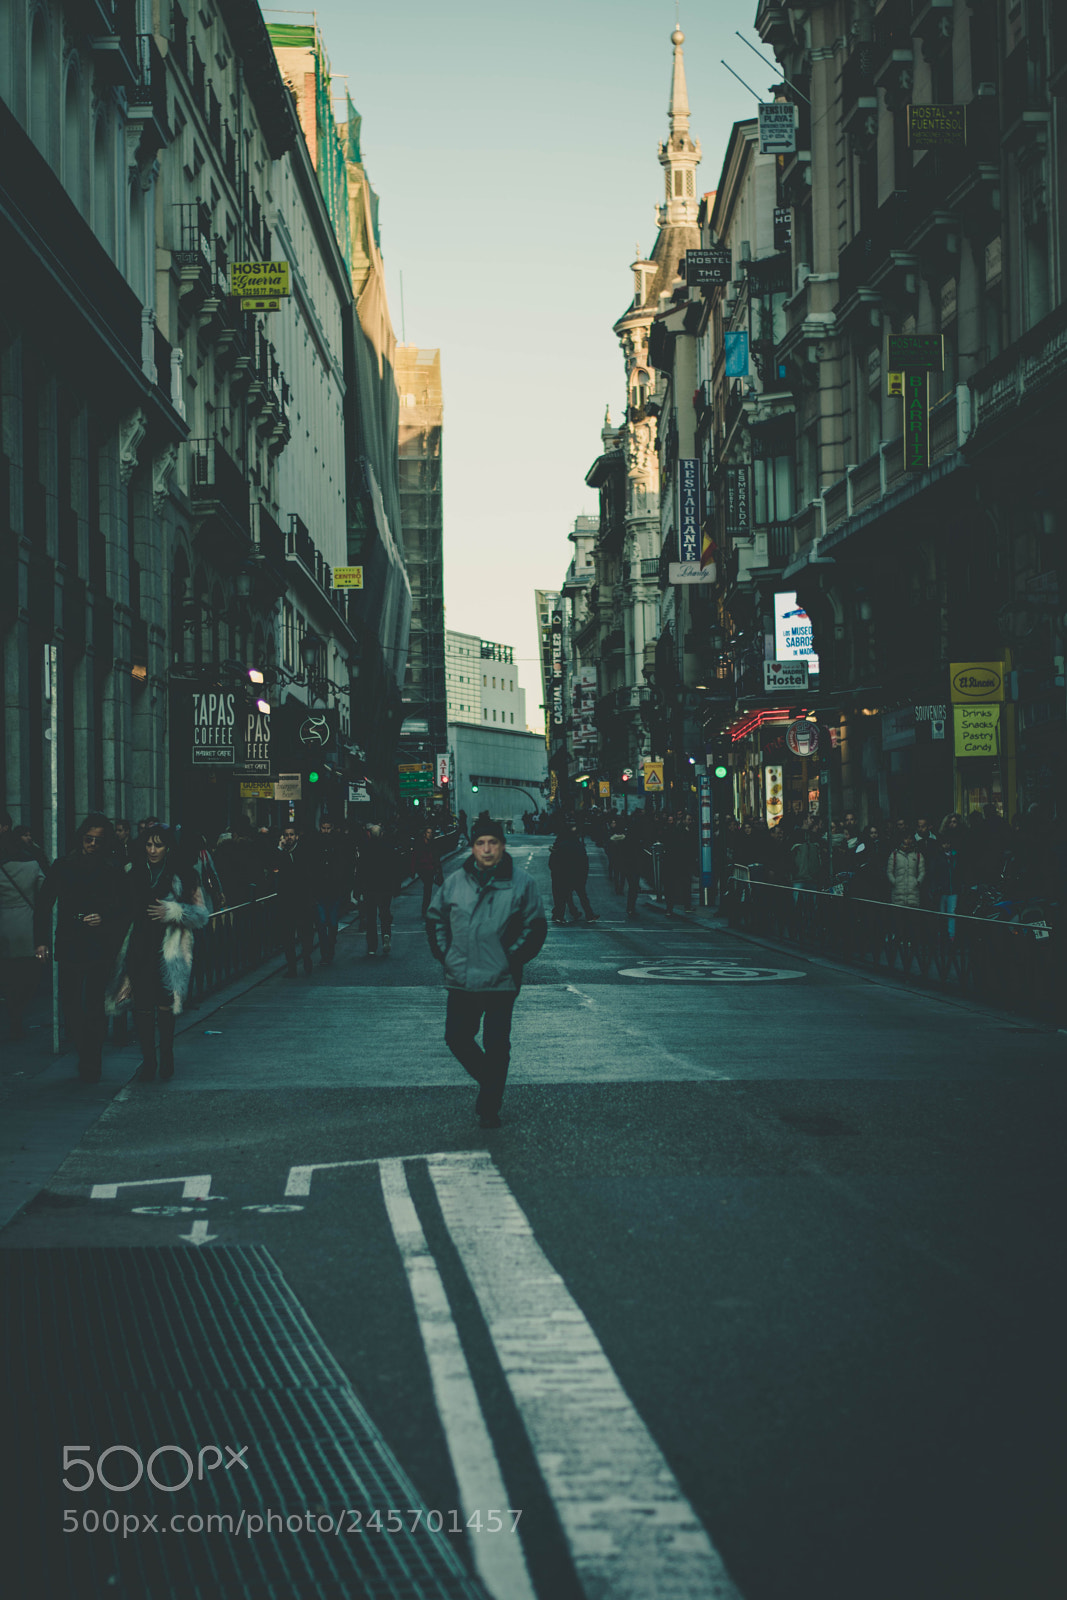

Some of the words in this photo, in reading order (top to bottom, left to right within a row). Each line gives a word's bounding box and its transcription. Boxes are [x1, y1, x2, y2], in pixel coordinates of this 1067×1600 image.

[912, 107, 947, 118] HOSTAL
[911, 119, 963, 130] FUENTESOL
[233, 263, 285, 274] HOSTAL
[237, 275, 281, 289] Guerra
[891, 337, 923, 348] HOSTAL
[909, 376, 924, 466] BIARRITZ
[737, 468, 747, 526] ESMERALDA
[683, 460, 697, 561] RESTAURANTE
[791, 626, 813, 635] MUSEO
[785, 636, 815, 648] SABROS
[766, 674, 806, 685] Hostel
[959, 677, 968, 688] El
[192, 693, 235, 726] TAPAS
[553, 684, 563, 725] CASUAL
[914, 704, 947, 721] SOUVENIRS
[962, 709, 992, 718] Drinks
[244, 713, 271, 742] PAS
[961, 720, 994, 729] Snacks
[194, 727, 233, 744] COFFEE
[962, 731, 993, 741] Pastry
[247, 743, 269, 759] FFEE
[964, 743, 992, 752] Candy
[661, 968, 760, 977] 30
